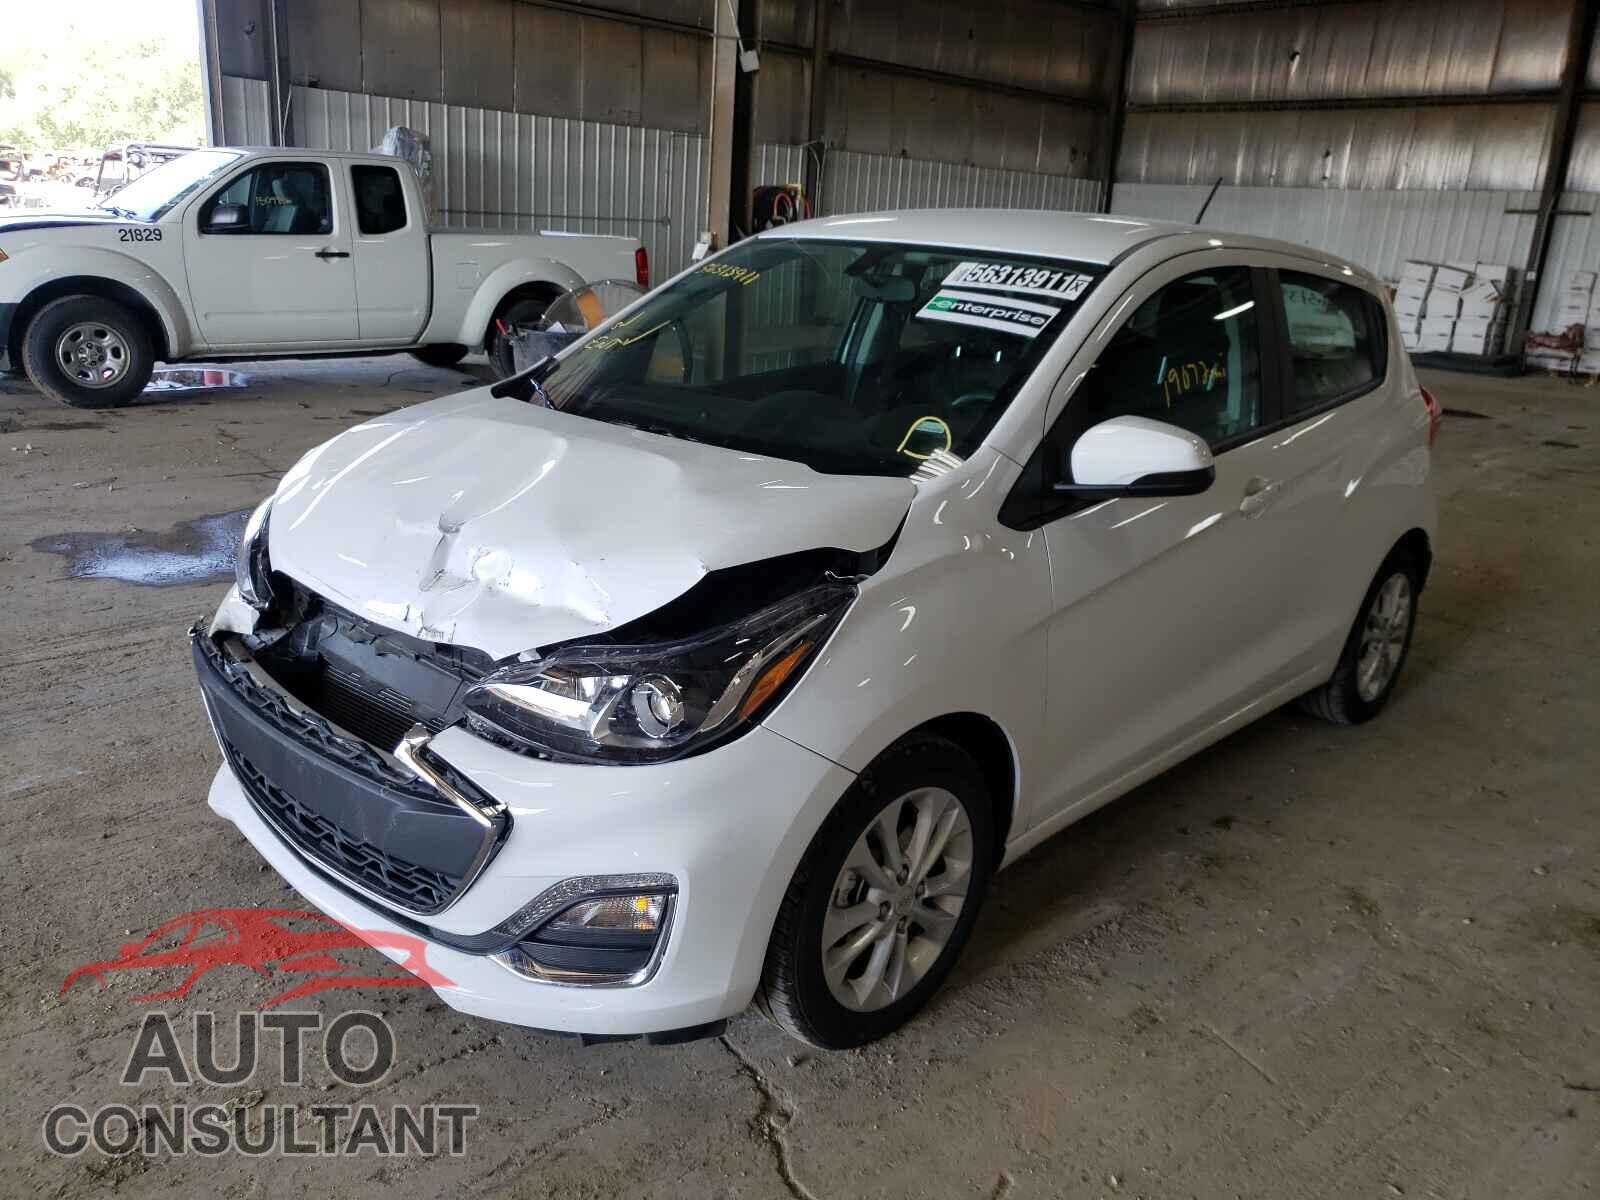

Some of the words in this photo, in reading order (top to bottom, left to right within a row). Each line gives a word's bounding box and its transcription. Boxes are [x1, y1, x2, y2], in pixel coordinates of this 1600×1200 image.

[118, 228, 163, 242] 21829
[966, 263, 1077, 292] 56313911
[932, 298, 1046, 326] enterprise
